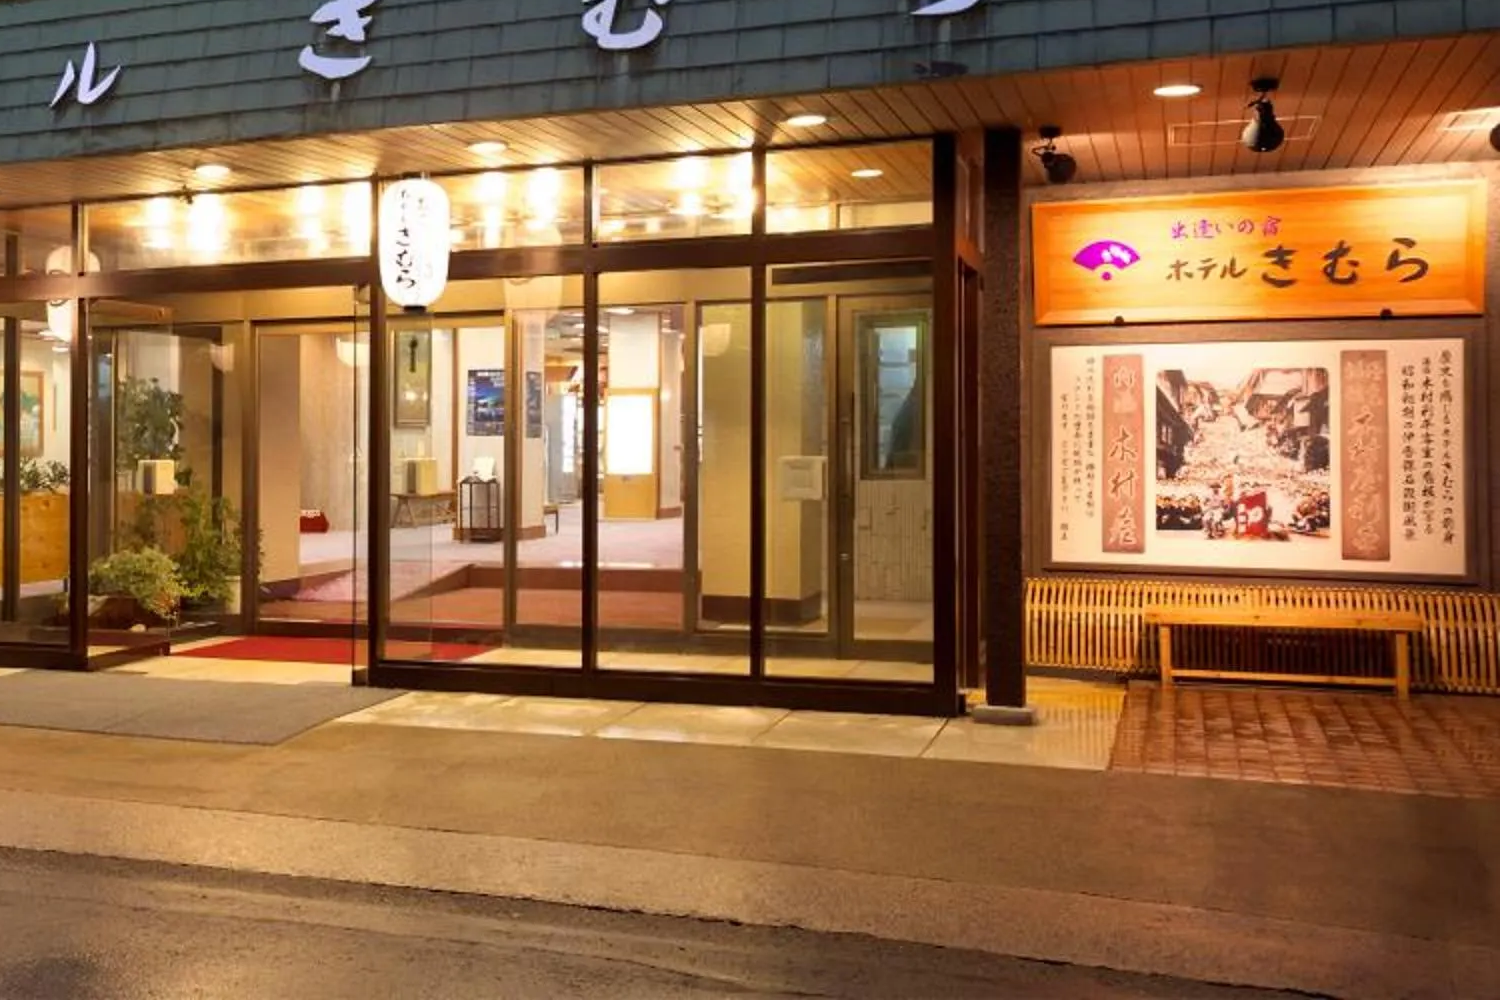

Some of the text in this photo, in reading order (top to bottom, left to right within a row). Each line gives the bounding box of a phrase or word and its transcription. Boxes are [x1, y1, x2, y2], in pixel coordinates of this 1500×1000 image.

[1165, 237, 1430, 288] ホテルきむら
